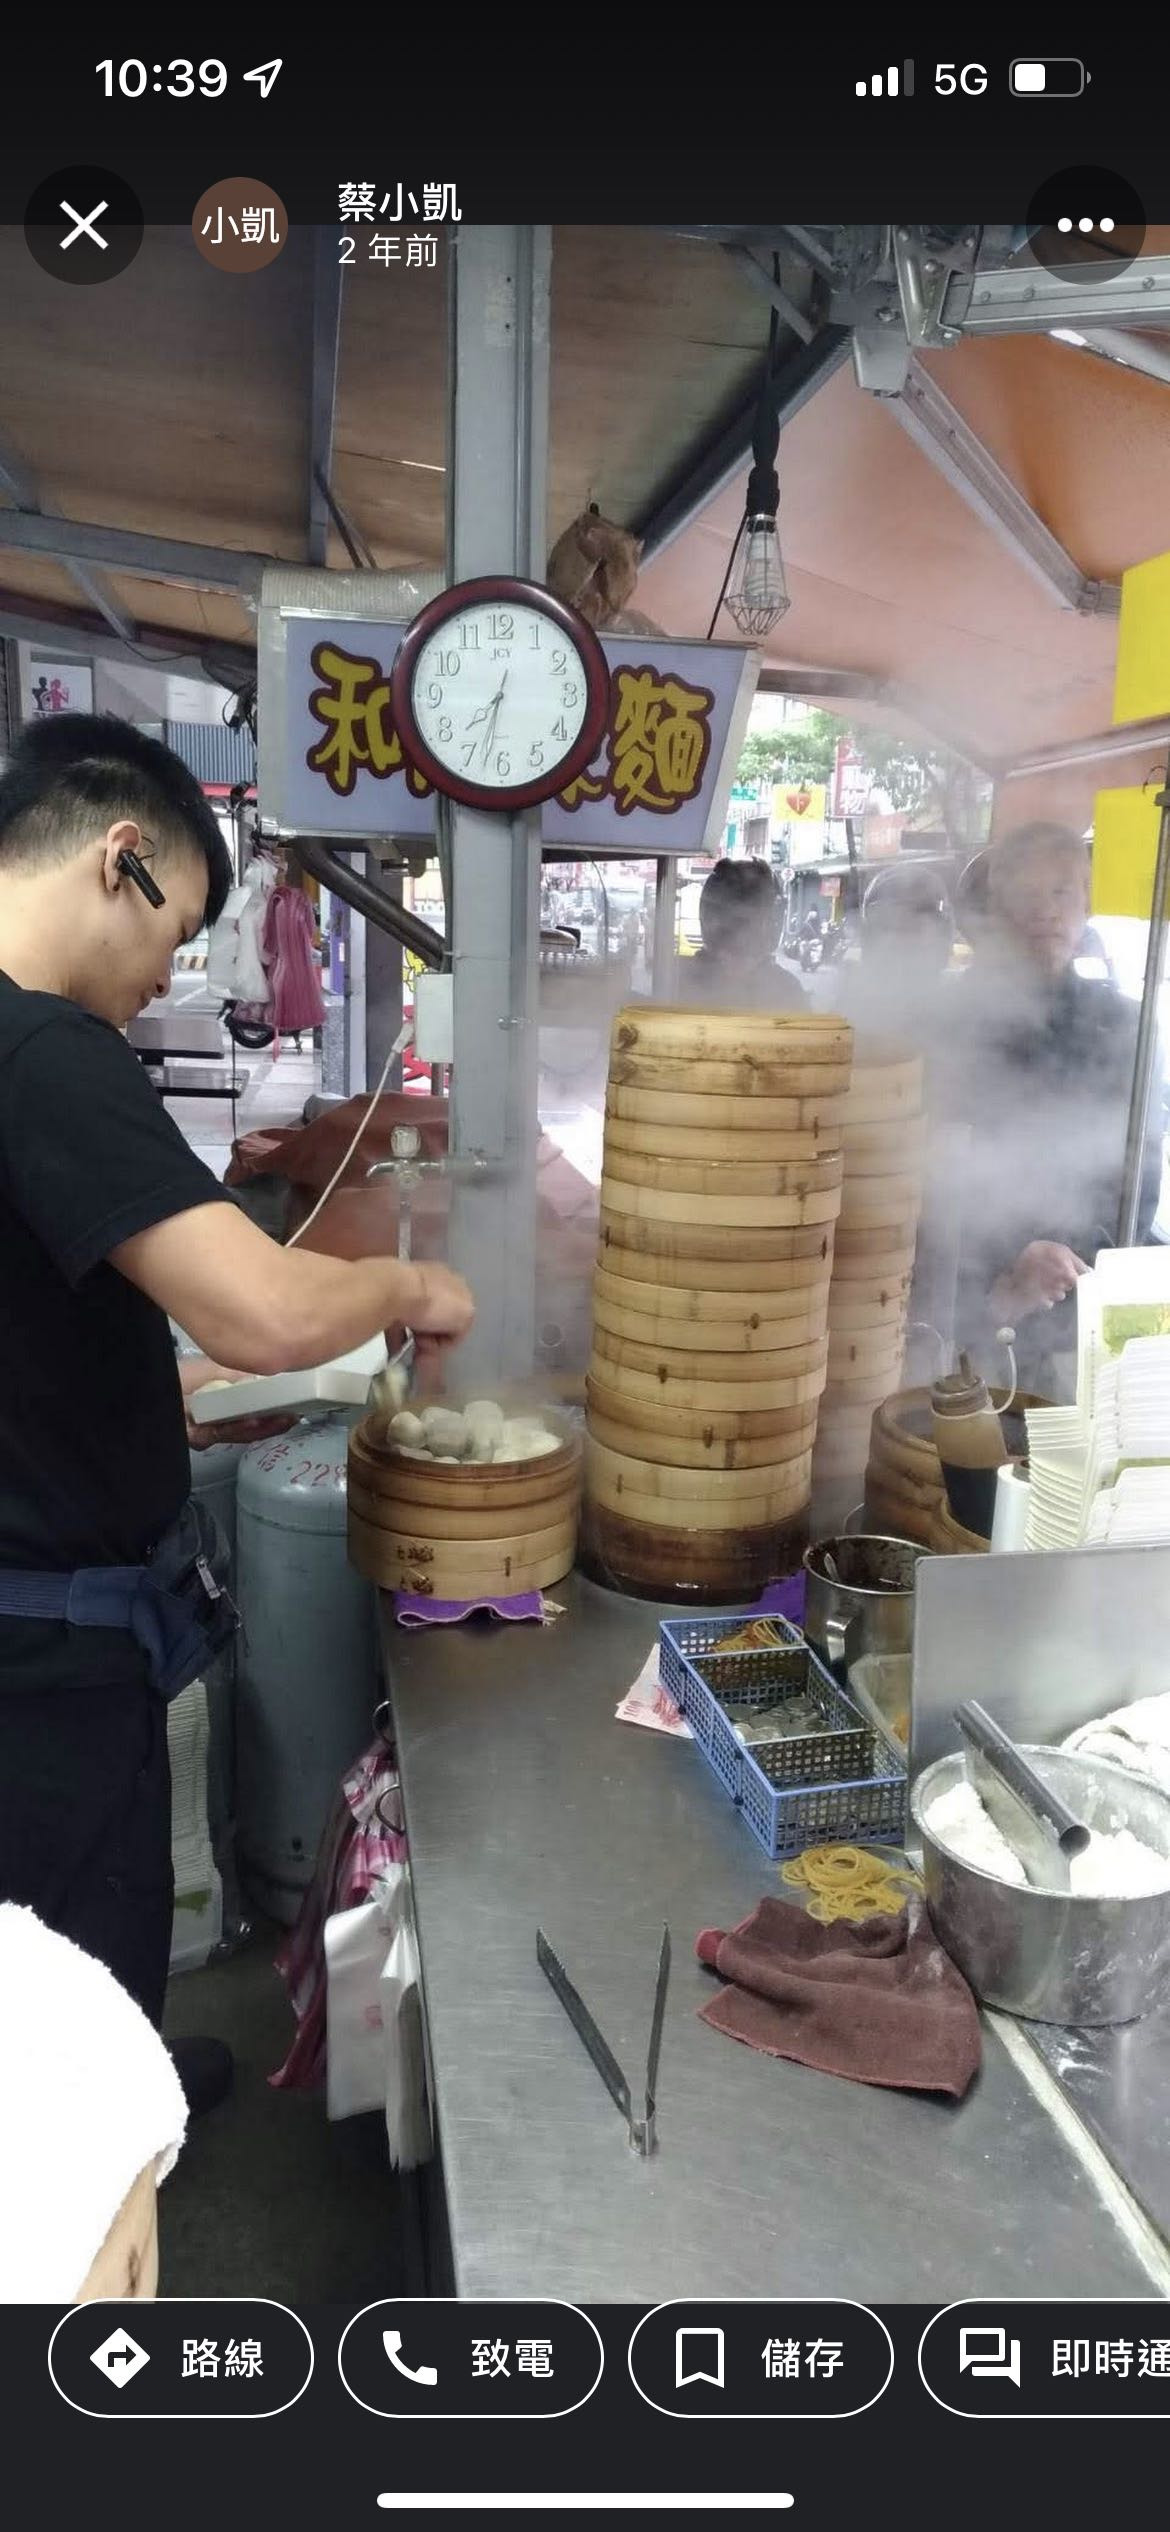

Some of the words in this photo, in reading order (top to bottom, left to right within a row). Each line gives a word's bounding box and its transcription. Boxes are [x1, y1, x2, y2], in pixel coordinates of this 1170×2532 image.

[458, 624, 481, 650] 11
[488, 614, 514, 640] 12
[528, 624, 541, 650] 1
[435, 650, 461, 677] 10
[550, 650, 567, 676] 2
[428, 683, 443, 709] 9
[563, 683, 577, 708] 3
[439, 716, 453, 742] 8
[551, 716, 568, 742] 4
[461, 742, 477, 767] 7
[496, 751, 510, 777] 6
[529, 741, 544, 766] 5
